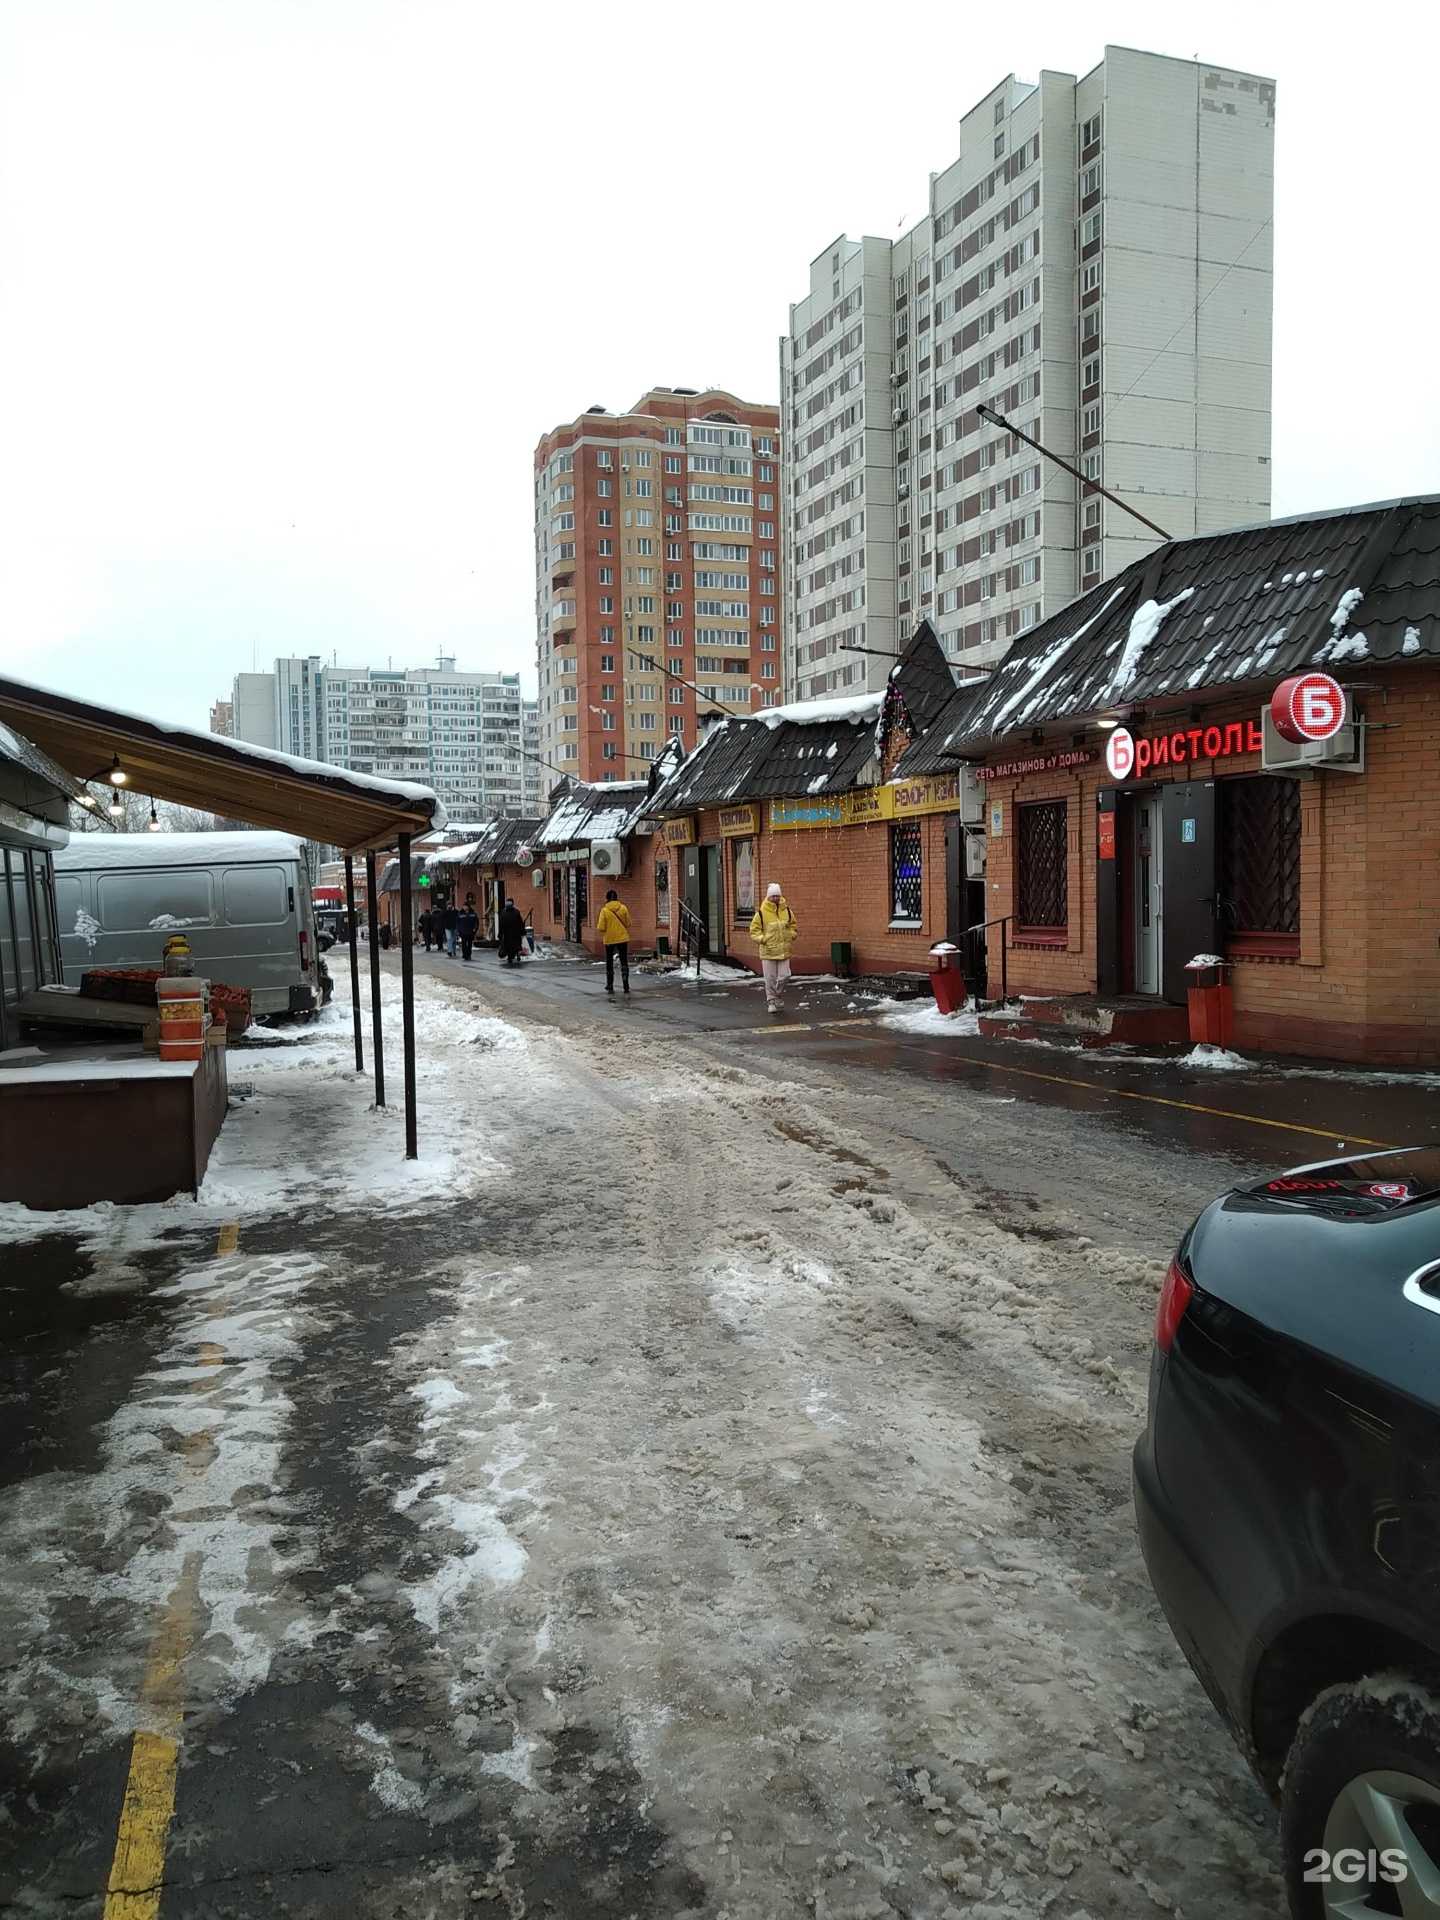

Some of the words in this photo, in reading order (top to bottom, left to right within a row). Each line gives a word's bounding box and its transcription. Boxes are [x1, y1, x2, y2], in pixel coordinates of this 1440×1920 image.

[1302, 687, 1334, 726] Б
[975, 766, 995, 780] СЕТЬ
[996, 757, 1045, 777] МАГАЗИНОВ
[1046, 756, 1058, 769] «У
[1060, 751, 1090, 768] ДОМА»
[1111, 720, 1264, 778] Бристоль
[894, 783, 932, 808] РЕМОНТ
